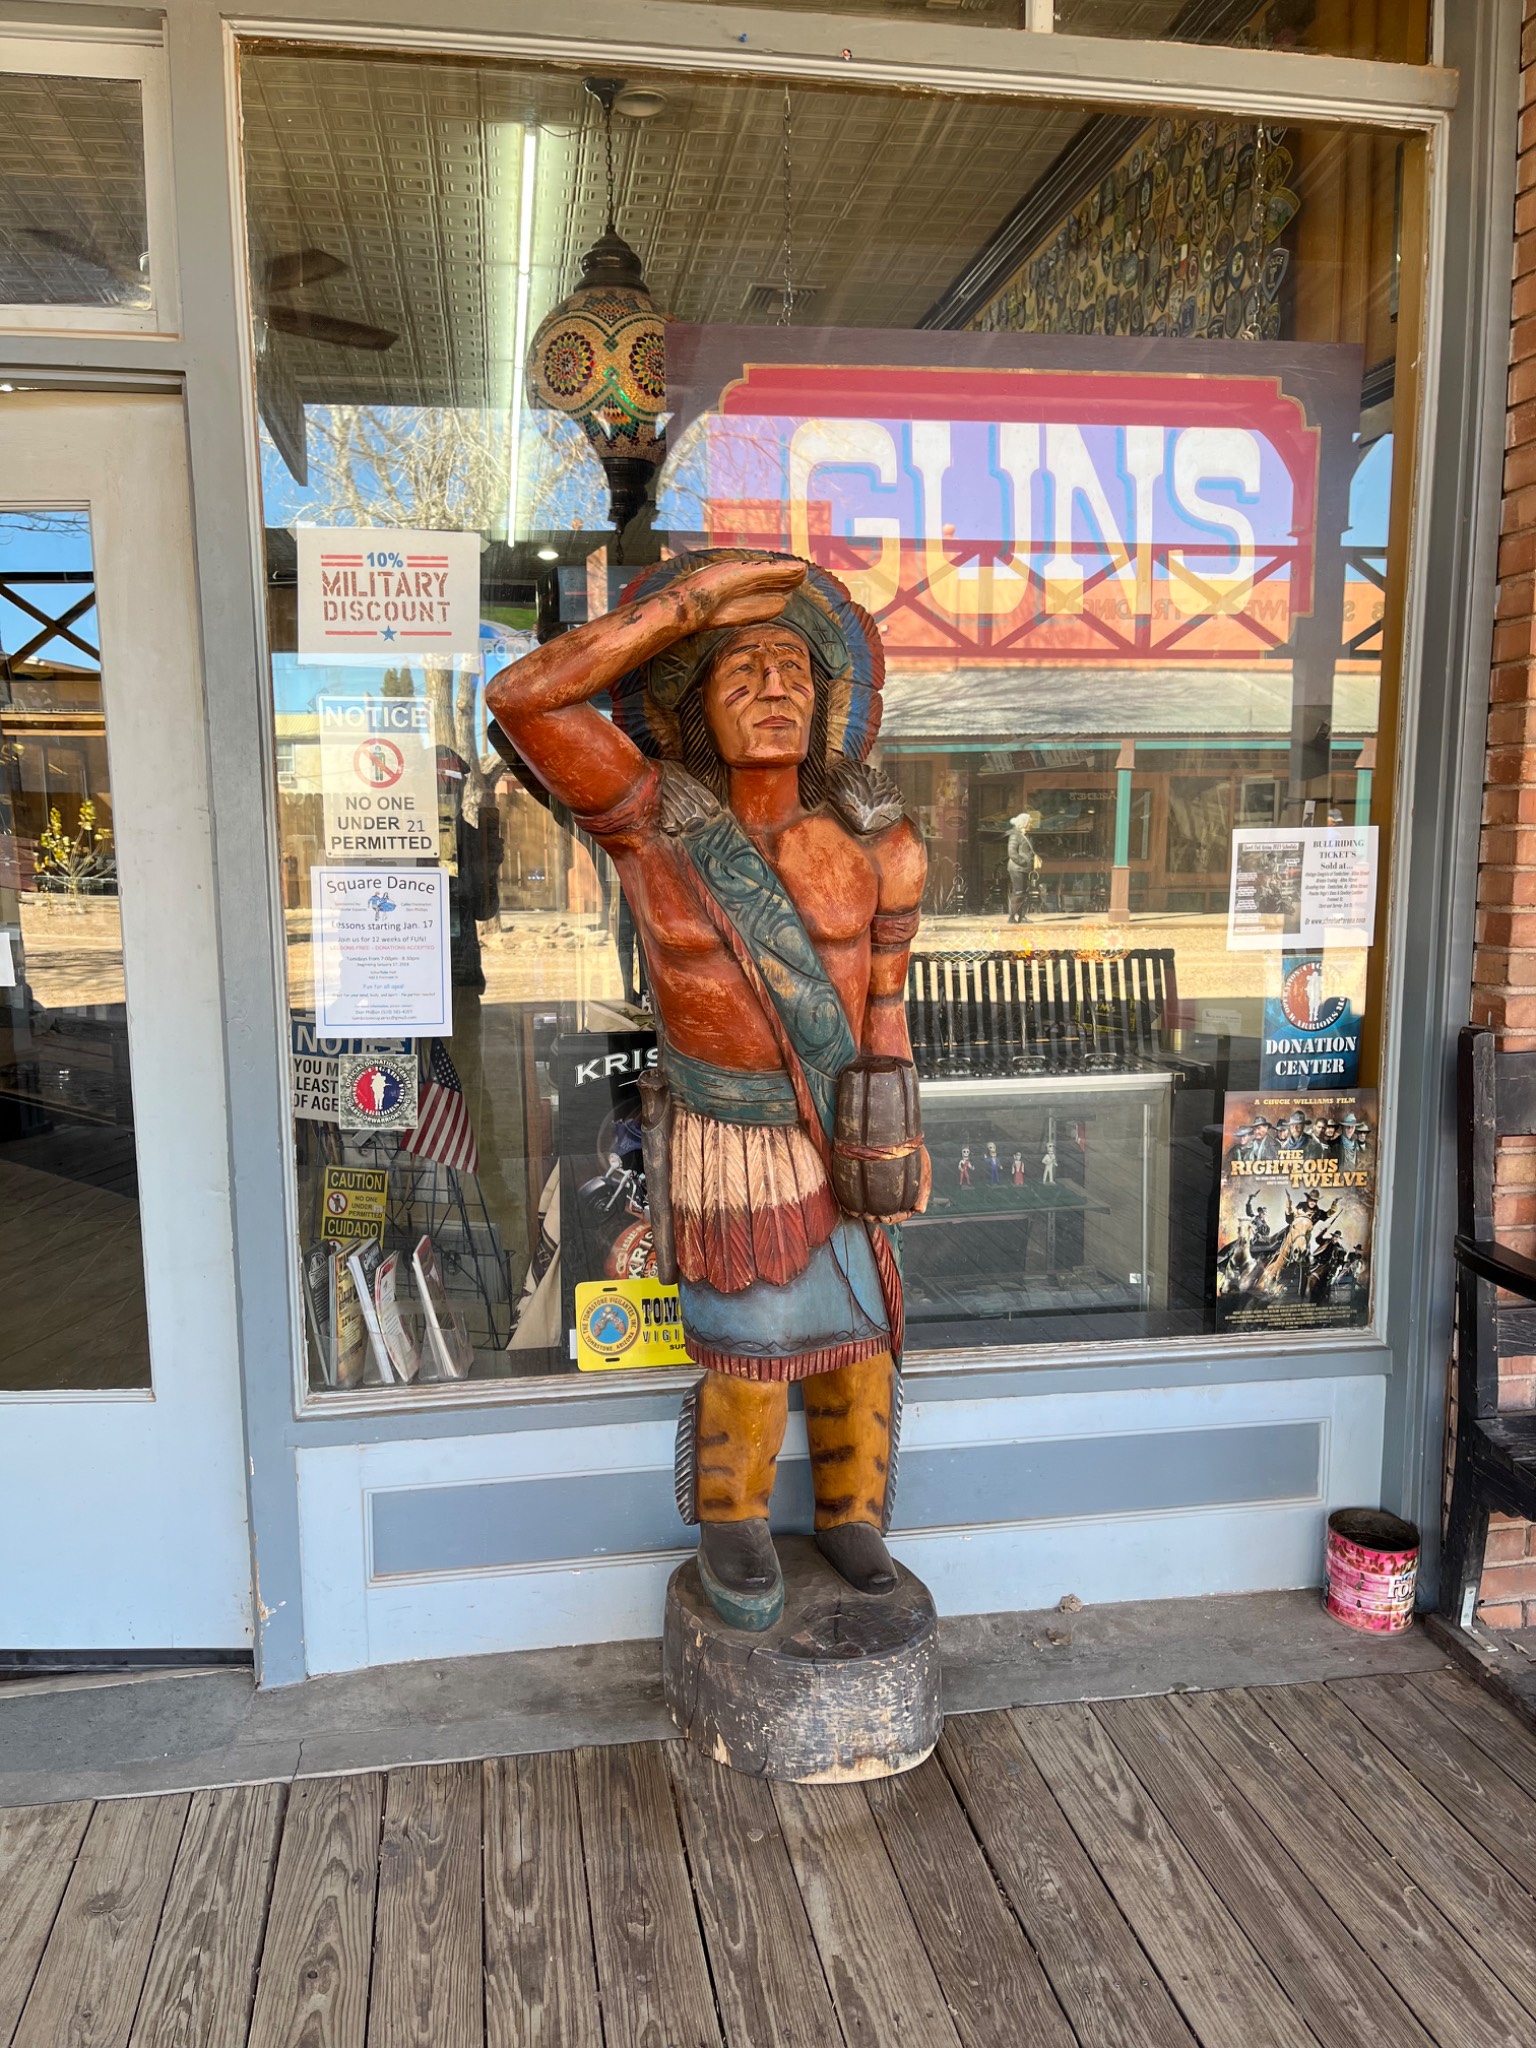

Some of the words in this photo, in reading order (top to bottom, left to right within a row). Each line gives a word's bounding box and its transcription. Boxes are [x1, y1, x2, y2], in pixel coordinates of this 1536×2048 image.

[789, 420, 1260, 615] GUNS
[367, 552, 404, 568] 10%
[321, 570, 449, 597] MILITARY
[323, 600, 450, 622] DISCOUNT
[326, 706, 429, 728] NOTICE
[346, 796, 371, 810] NO
[377, 796, 415, 810] ONE
[338, 816, 400, 830] UNDER
[407, 820, 426, 832] 21
[331, 836, 433, 850] PERMITTED
[1320, 862, 1338, 870] Sold
[327, 878, 382, 894] Square
[387, 875, 435, 894] Dance
[332, 920, 366, 930] Lessons
[367, 921, 401, 931] starting
[423, 920, 433, 929] 17
[1265, 1036, 1357, 1055] DONATION
[294, 1058, 322, 1075] YOU
[365, 1059, 398, 1069] DONATION
[574, 1046, 658, 1087] KRIS
[1275, 1058, 1345, 1076] CENTER
[296, 1076, 339, 1095] LEAST
[311, 1095, 339, 1112] AGE
[1278, 1150, 1304, 1160] THE
[1230, 1158, 1339, 1176] RIGHTEOUS
[331, 1171, 383, 1191] CAUTION
[1290, 1171, 1368, 1188] TWELVE
[348, 1210, 383, 1219] PERMITTED
[352, 1202, 373, 1210] UNDER
[327, 1219, 379, 1238] CUIDADO
[616, 1332, 635, 1349] ARIZONA
